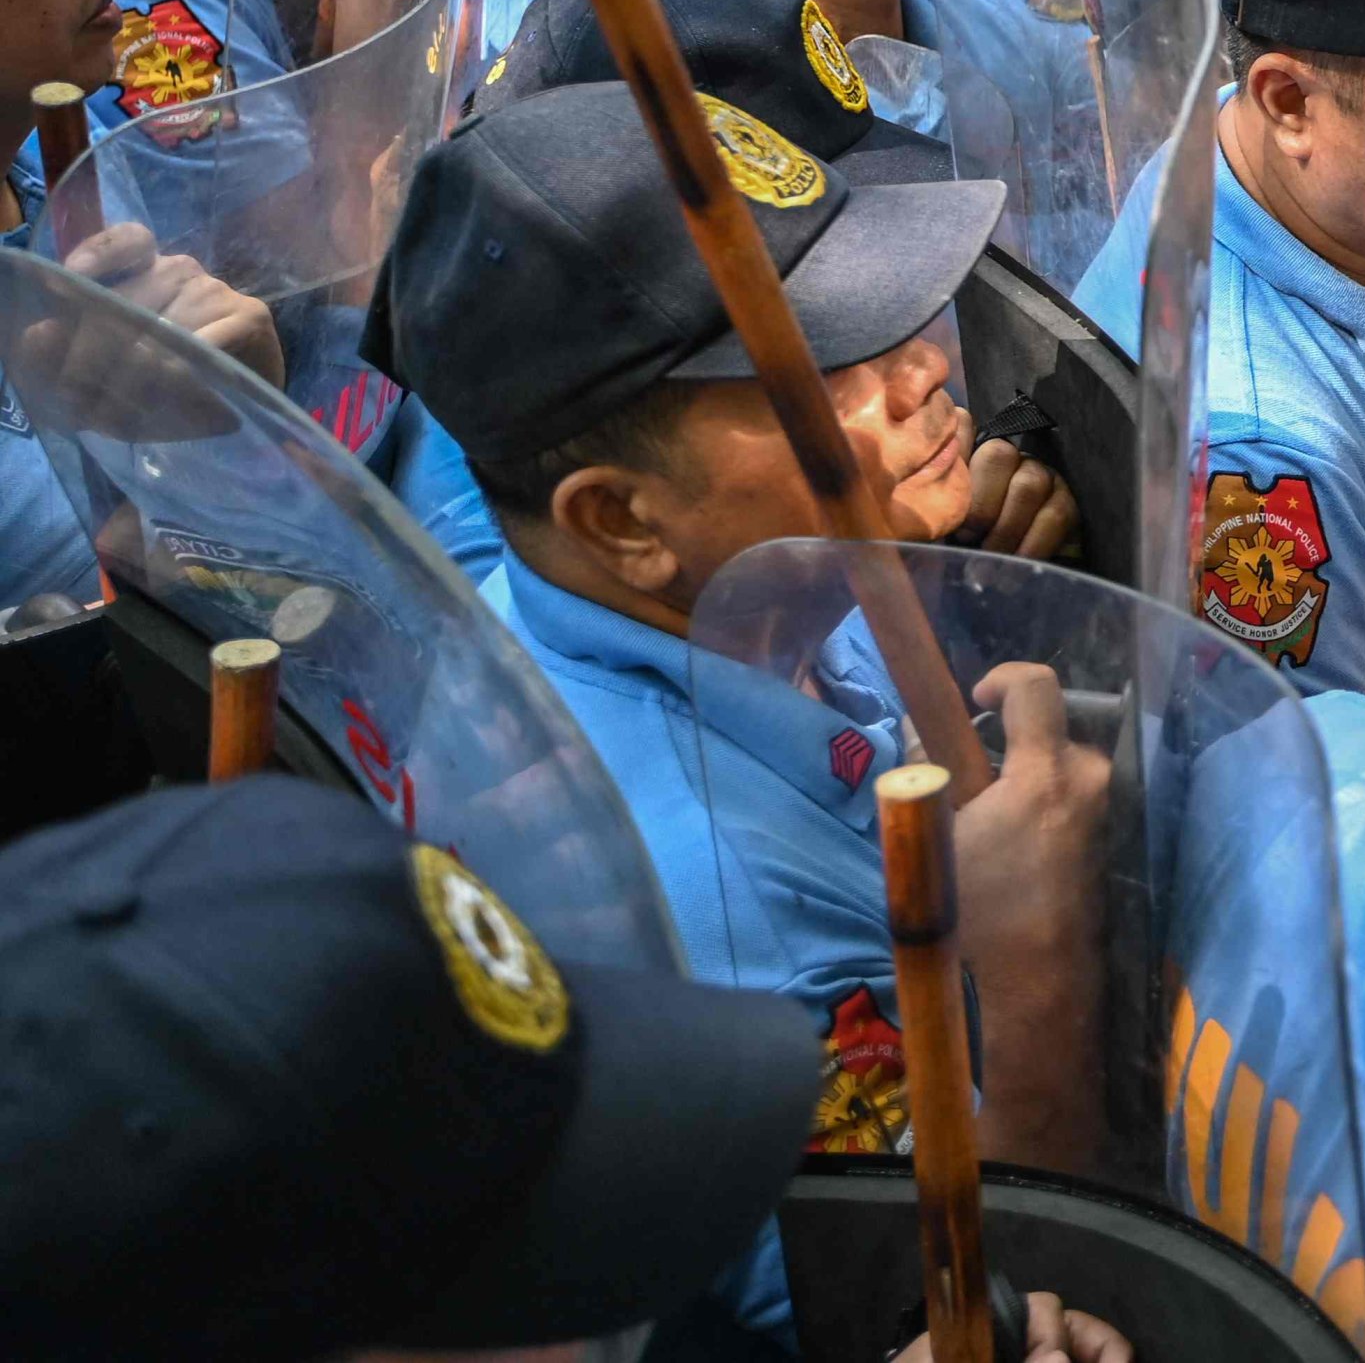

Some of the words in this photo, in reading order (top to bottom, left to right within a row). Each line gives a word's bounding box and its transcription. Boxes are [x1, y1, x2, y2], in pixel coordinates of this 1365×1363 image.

[1203, 514, 1244, 559] HILIPPINE
[1245, 512, 1294, 532] NATIONAL
[1294, 526, 1321, 563] POLICE
[1211, 607, 1247, 636] SERVICE
[1249, 628, 1278, 638] HONOR
[1280, 606, 1308, 633] JUSTICE
